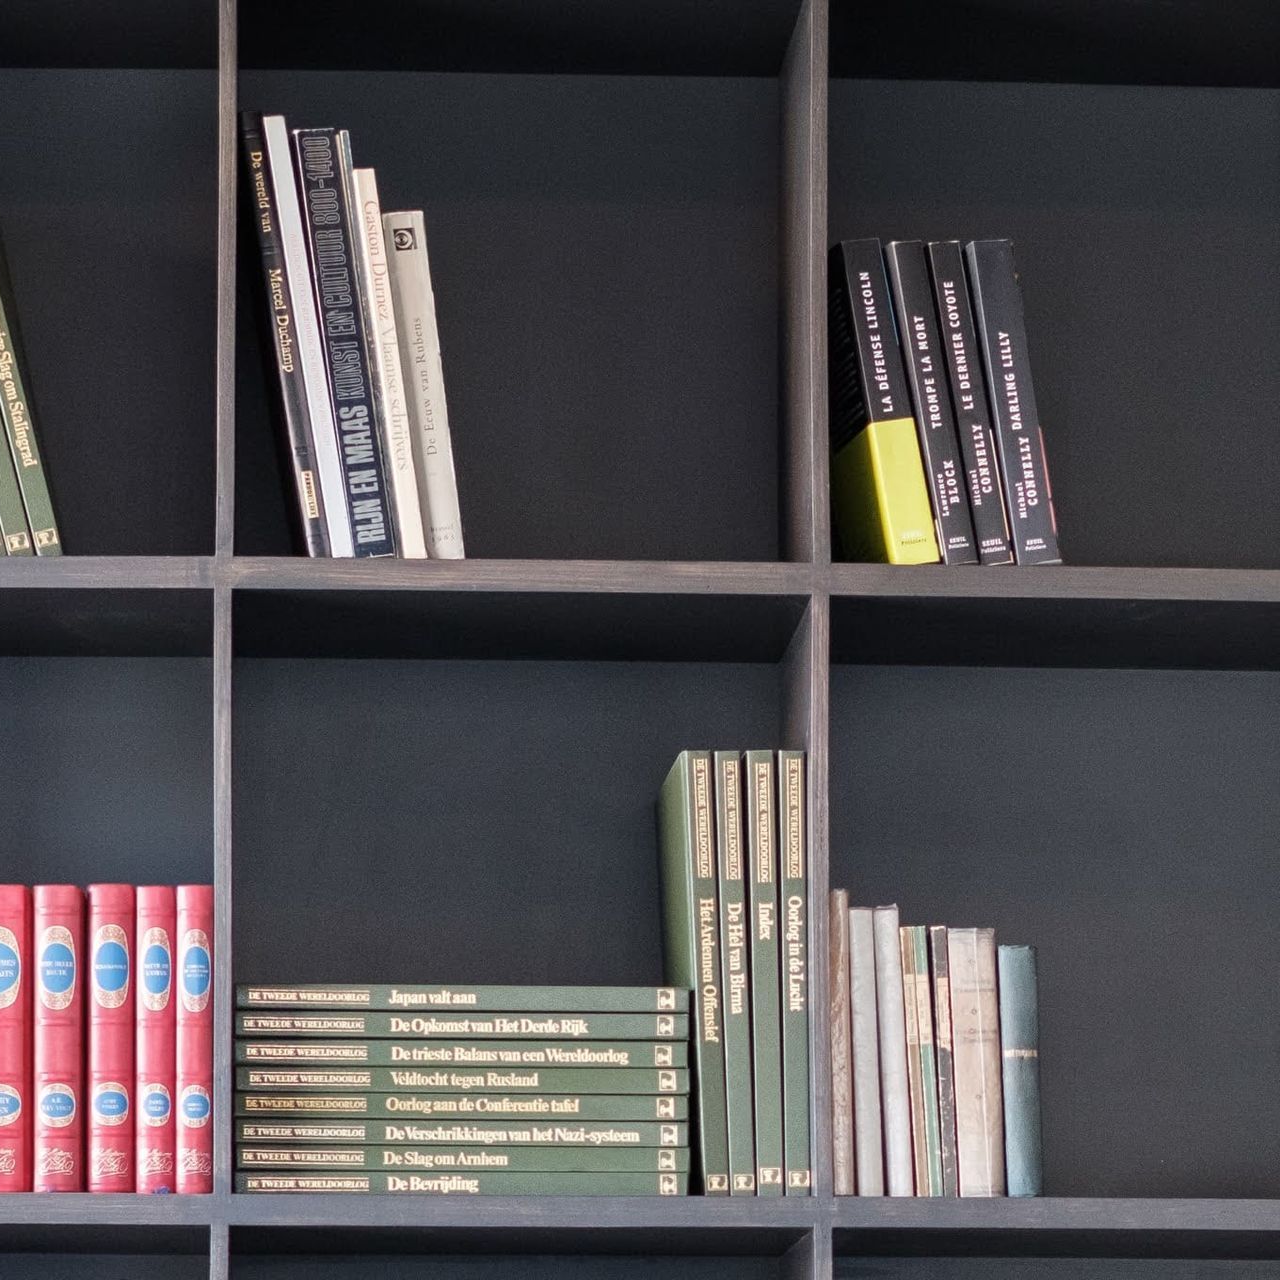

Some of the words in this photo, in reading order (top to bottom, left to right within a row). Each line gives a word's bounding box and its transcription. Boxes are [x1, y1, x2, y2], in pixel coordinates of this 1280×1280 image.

[250, 150, 263, 168] De
[254, 171, 270, 208] wereld
[301, 134, 341, 226] 800-1400
[260, 211, 272, 232] van
[362, 200, 384, 256] Gaston
[314, 227, 352, 308] CULTUUR
[268, 268, 286, 309] Marcel
[371, 262, 392, 320] Durnez
[859, 271, 878, 329] LINCOLN
[943, 280, 960, 328] COYOTE
[325, 310, 356, 337] EN
[411, 316, 426, 363] Rubens
[913, 314, 928, 350] MORT
[275, 314, 295, 373] Duchamp
[868, 333, 889, 390] DÉFENSE
[951, 332, 970, 389] DERNIER
[998, 330, 1012, 367] LILLY
[329, 337, 365, 400] KUNST
[418, 369, 429, 391] van
[920, 355, 932, 372] LA
[421, 397, 435, 430] Eeuw
[881, 395, 893, 412] LA
[924, 377, 942, 428] TROMPE
[962, 394, 974, 409] LE
[1004, 372, 1022, 430] DARLING
[338, 403, 374, 465] MAAS
[425, 437, 437, 455] De
[971, 423, 992, 493] CONNELLY
[347, 468, 379, 494] EN
[935, 472, 949, 516] Lawrence
[943, 459, 960, 504] BLOCK
[968, 468, 982, 505] Michael
[351, 497, 386, 543] RIJN
[727, 902, 741, 921] De
[758, 902, 772, 939] Index
[728, 923, 742, 946] Hel
[729, 948, 741, 970] van
[249, 992, 261, 1000] DE
[300, 993, 369, 1001] WERELDOORLOG
[730, 973, 744, 1014] Birma
[391, 1018, 410, 1032] De
[411, 1019, 470, 1034] Opkomst
[470, 1021, 492, 1033] van
[495, 1020, 519, 1033] Het
[521, 1020, 559, 1033] Derde
[561, 1020, 588, 1035] Rijk
[391, 1072, 449, 1086] Veldtocht
[451, 1073, 484, 1088] tegen
[487, 1073, 538, 1086] Rusland
[383, 1152, 402, 1165] De
[404, 1152, 433, 1167] Slag
[434, 1156, 455, 1165] om
[457, 1152, 508, 1166] Arnhem
[388, 1177, 408, 1191] De
[410, 1177, 479, 1193] Bevrijding
